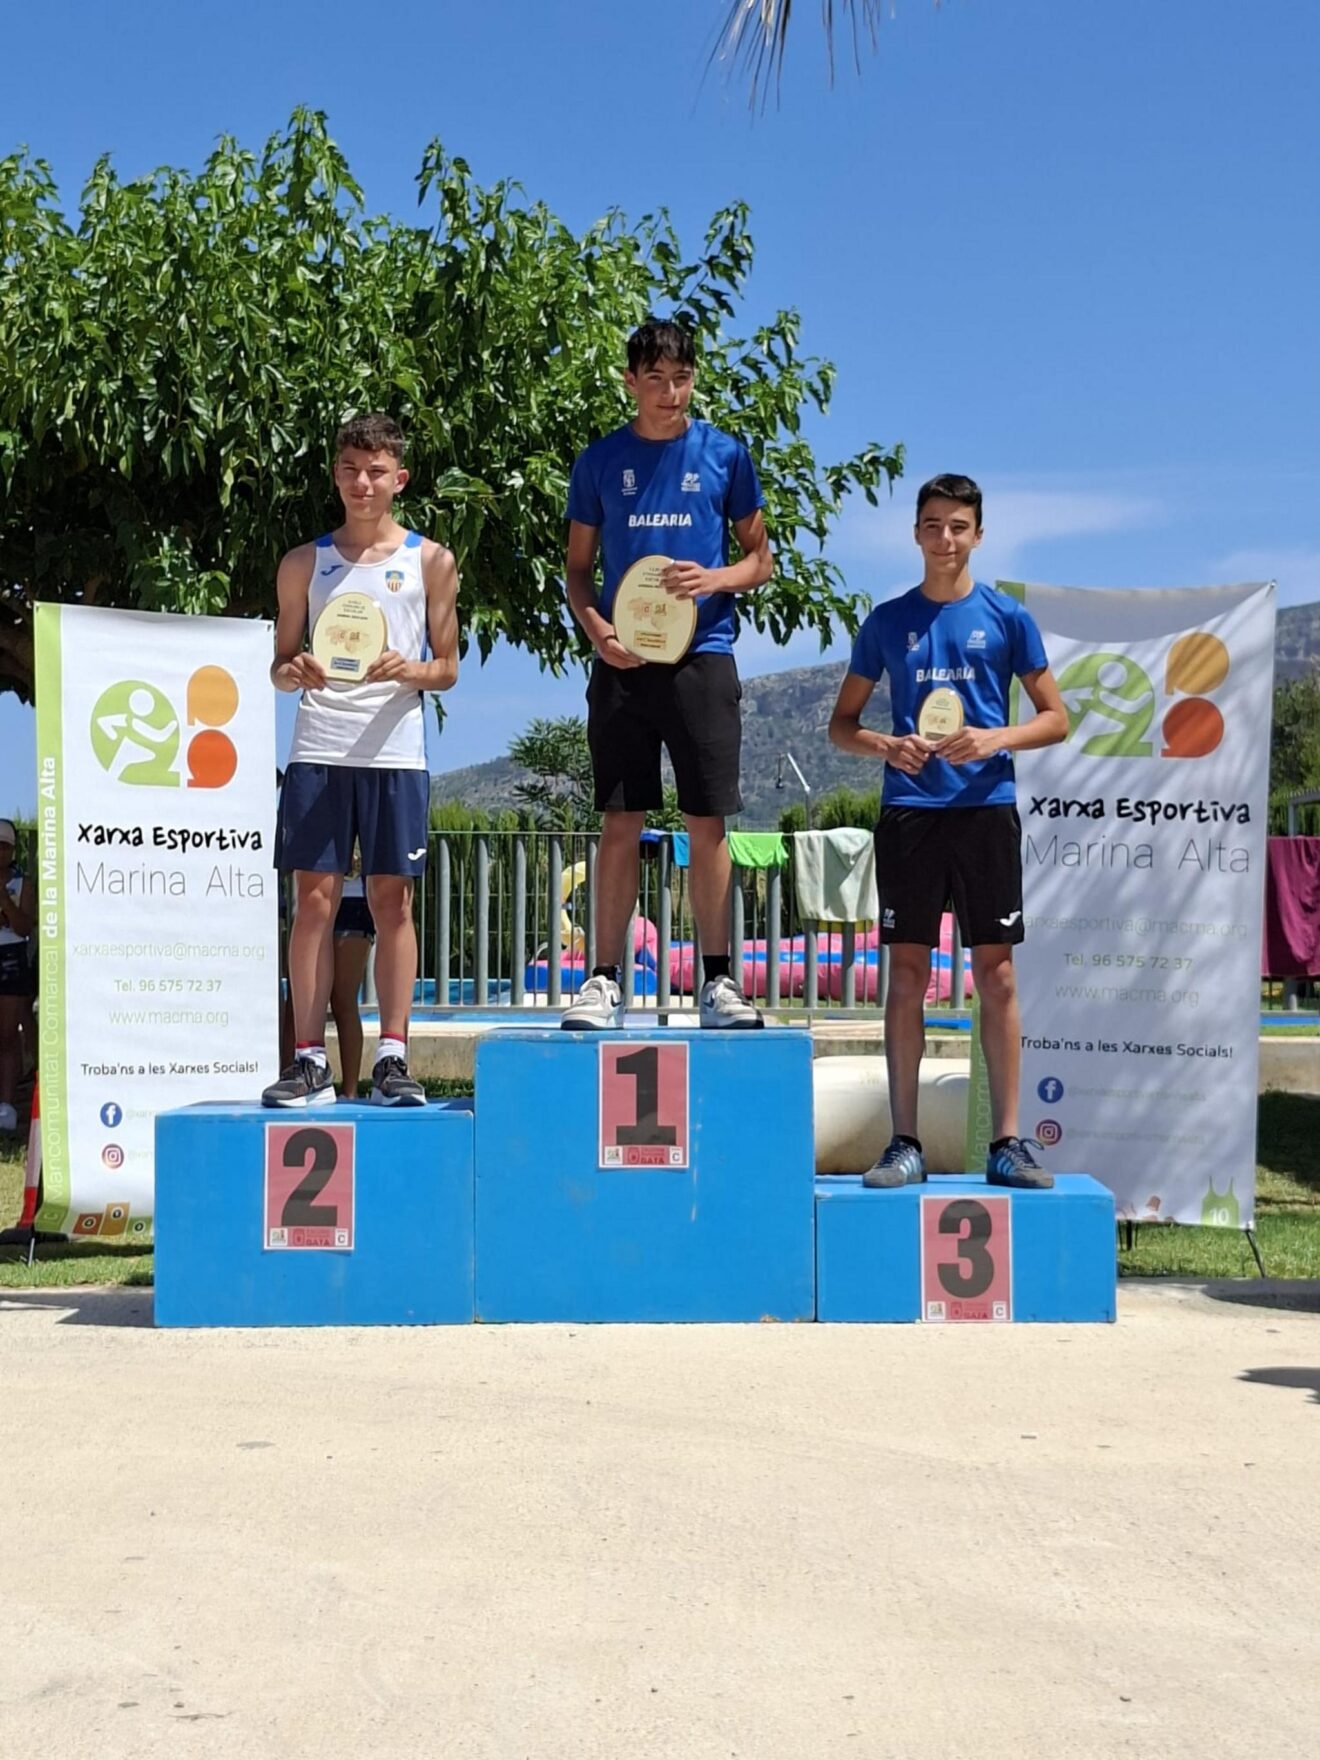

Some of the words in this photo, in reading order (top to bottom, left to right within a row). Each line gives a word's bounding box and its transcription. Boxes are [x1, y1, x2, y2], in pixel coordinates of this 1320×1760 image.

[628, 513, 692, 528] BALEARIA
[40, 757, 57, 800] Alta
[1115, 796, 1250, 827] Esportiva
[40, 805, 58, 881] Marina
[152, 825, 263, 854] Esportiva
[1025, 834, 1154, 870] Marina
[1178, 837, 1250, 873] Alta
[76, 860, 186, 897] Marina
[205, 863, 264, 898] Alta
[41, 886, 58, 906] la
[42, 910, 58, 938] de
[1024, 915, 1248, 938] arxaesportiva@macma.org
[72, 942, 265, 961] xarxaesportiva@macma.org
[1092, 953, 1112, 967] 96
[1116, 954, 1146, 968] 575
[1150, 956, 1169, 970] 72
[1175, 957, 1193, 970] 37
[42, 944, 61, 1045] Comarcal
[114, 978, 136, 993] Tel.
[138, 979, 156, 992] 96
[158, 979, 184, 992] 575
[186, 979, 203, 992] 72
[205, 979, 223, 993] 37
[1055, 985, 1200, 1008] www.macma.org
[108, 1010, 230, 1027] www.macma.org
[1021, 1035, 1081, 1051] Troba'ns
[1084, 1041, 1093, 1052] a
[1097, 1038, 1118, 1053] les
[1122, 1040, 1172, 1055] Xarxes
[1176, 1043, 1233, 1059] Socials!
[81, 1061, 133, 1076] Troba'ns
[137, 1064, 146, 1076] a
[148, 1061, 165, 1075] les
[168, 1061, 210, 1076] Xarxes
[212, 1060, 259, 1075] Socials!
[616, 1046, 677, 1145] 1
[43, 1052, 64, 1202] Mancomunitat
[281, 1127, 338, 1226] 2
[937, 1198, 994, 1299] 3
